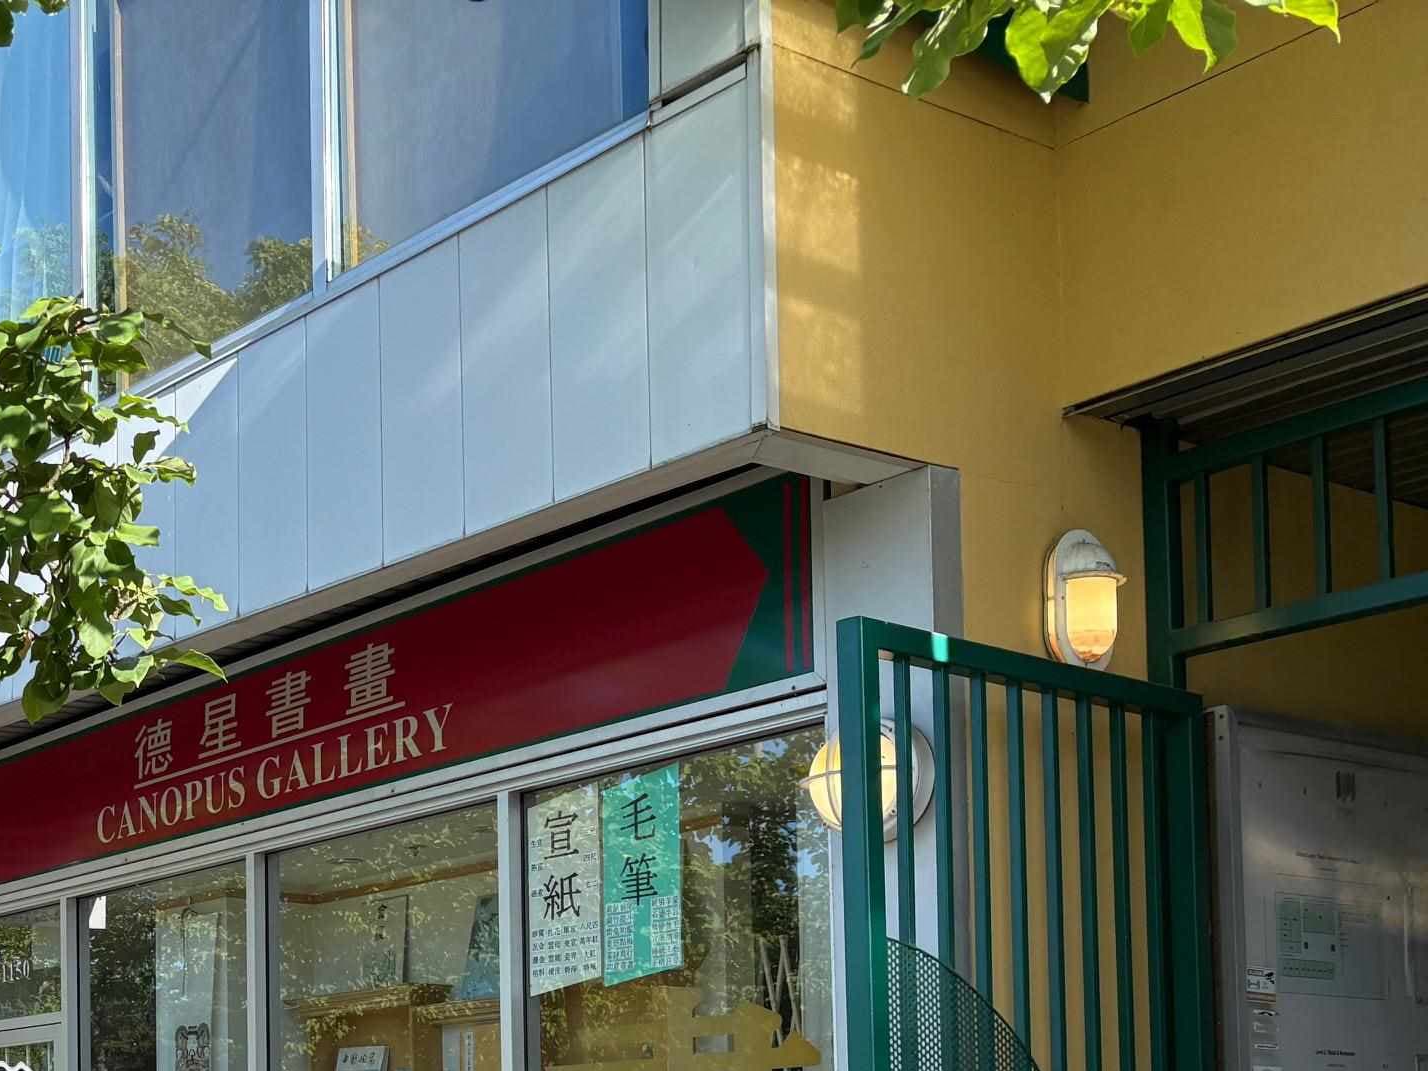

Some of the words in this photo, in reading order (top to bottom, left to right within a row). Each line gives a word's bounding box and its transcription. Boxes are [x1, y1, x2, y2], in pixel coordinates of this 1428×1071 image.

[96, 765, 246, 844] CANOPUS
[256, 702, 453, 800] GALLERY
[134, 642, 396, 780] 德星書畫
[543, 810, 582, 921] 宣紙
[620, 793, 659, 906] 毛筆
